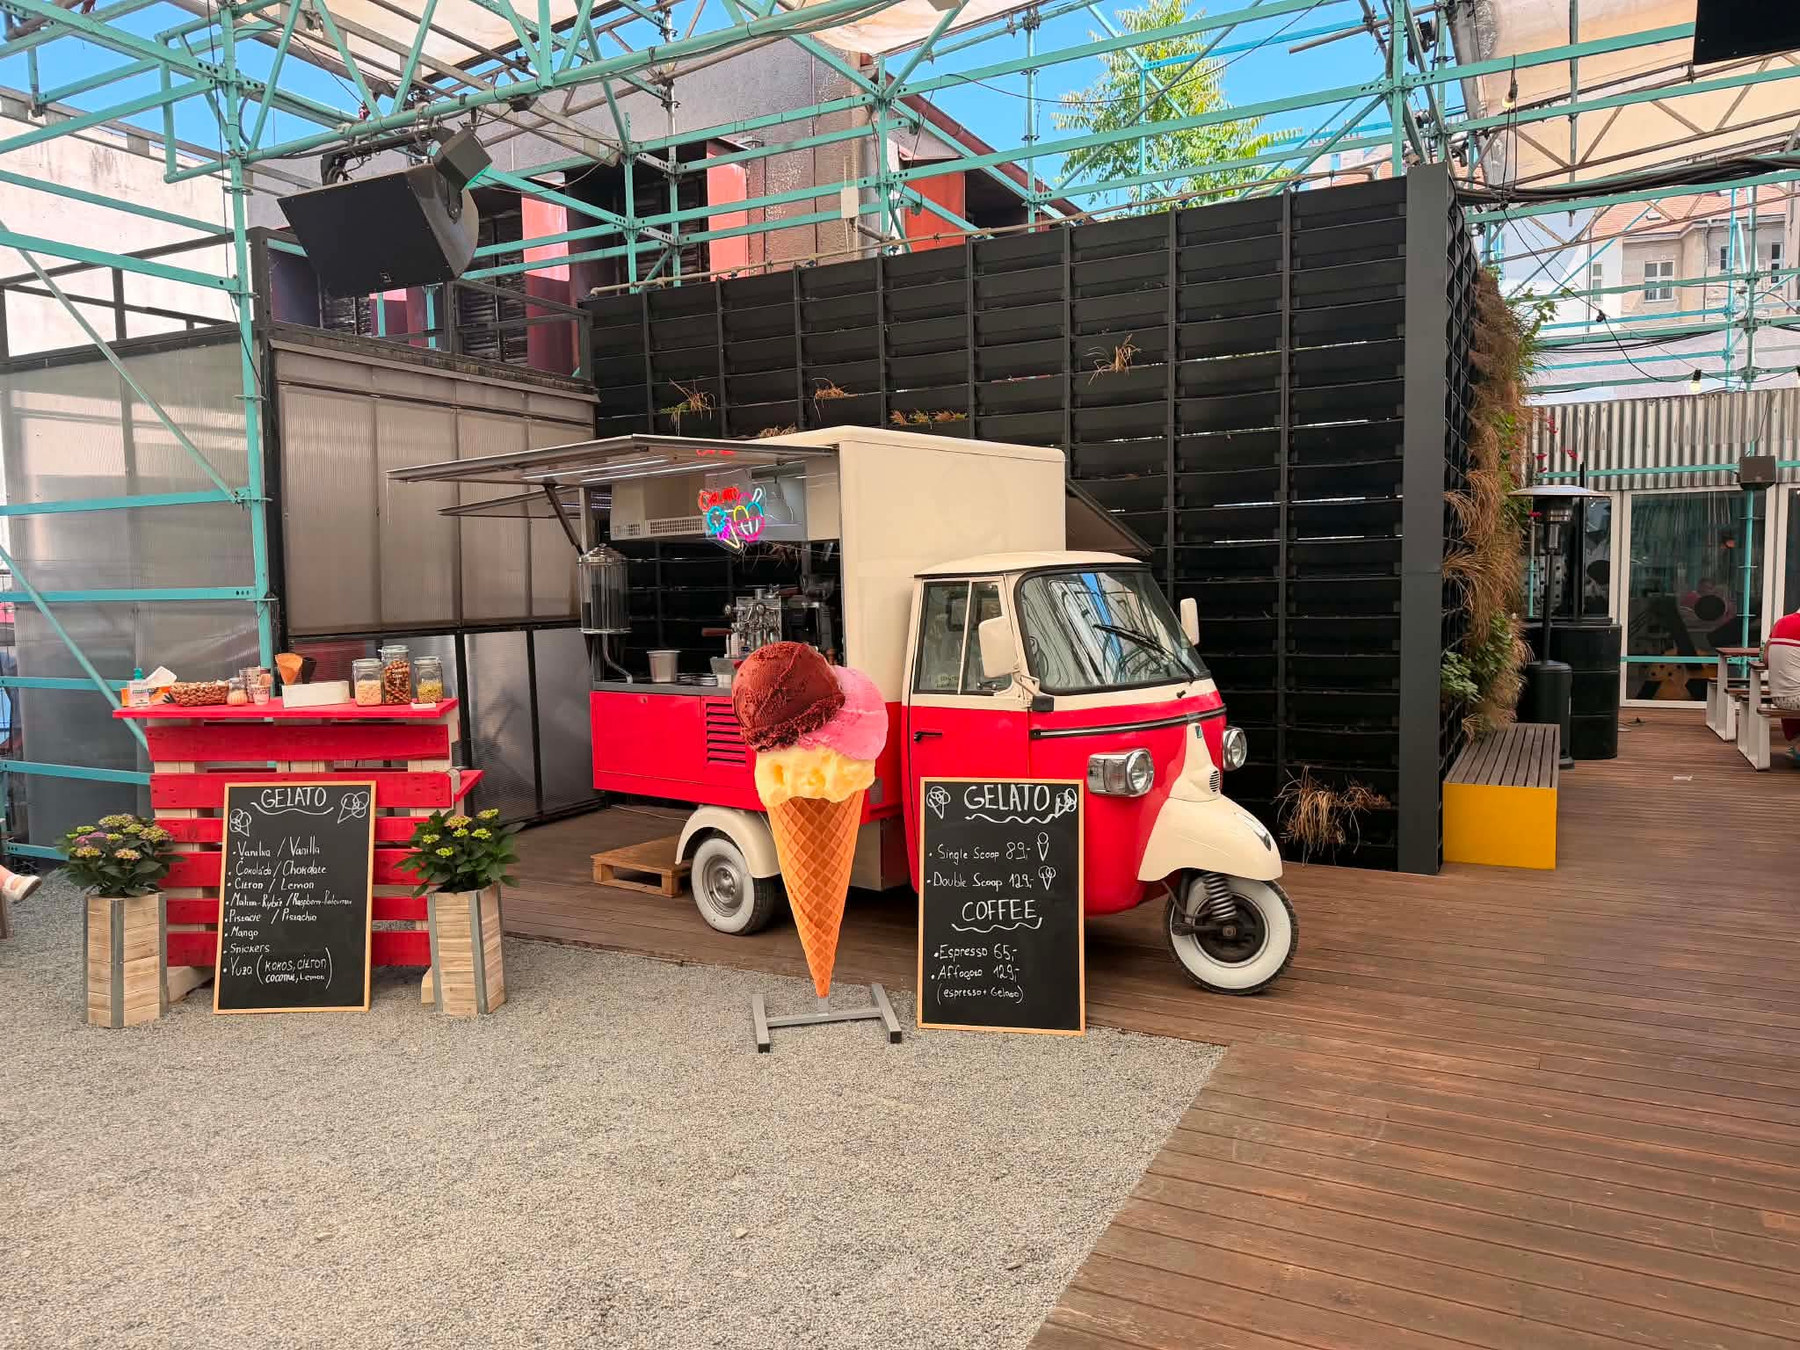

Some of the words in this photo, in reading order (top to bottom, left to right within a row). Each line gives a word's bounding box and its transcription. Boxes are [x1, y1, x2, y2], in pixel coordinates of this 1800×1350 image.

[261, 787, 327, 808] GELATO
[964, 784, 1050, 812] GELATO
[237, 840, 271, 857] Vanilka
[289, 835, 320, 856] Vanilla
[937, 844, 968, 865] Single
[973, 846, 1000, 863] Scoop
[234, 878, 263, 890] Citron
[281, 878, 314, 891] Lemon
[933, 871, 967, 887] Double
[972, 873, 1002, 891] Scoop
[281, 909, 317, 922] Pistachio
[961, 899, 1037, 922] COFFEE
[230, 926, 258, 940] Mango
[230, 943, 270, 954] Snickers
[939, 944, 988, 962] Espresso
